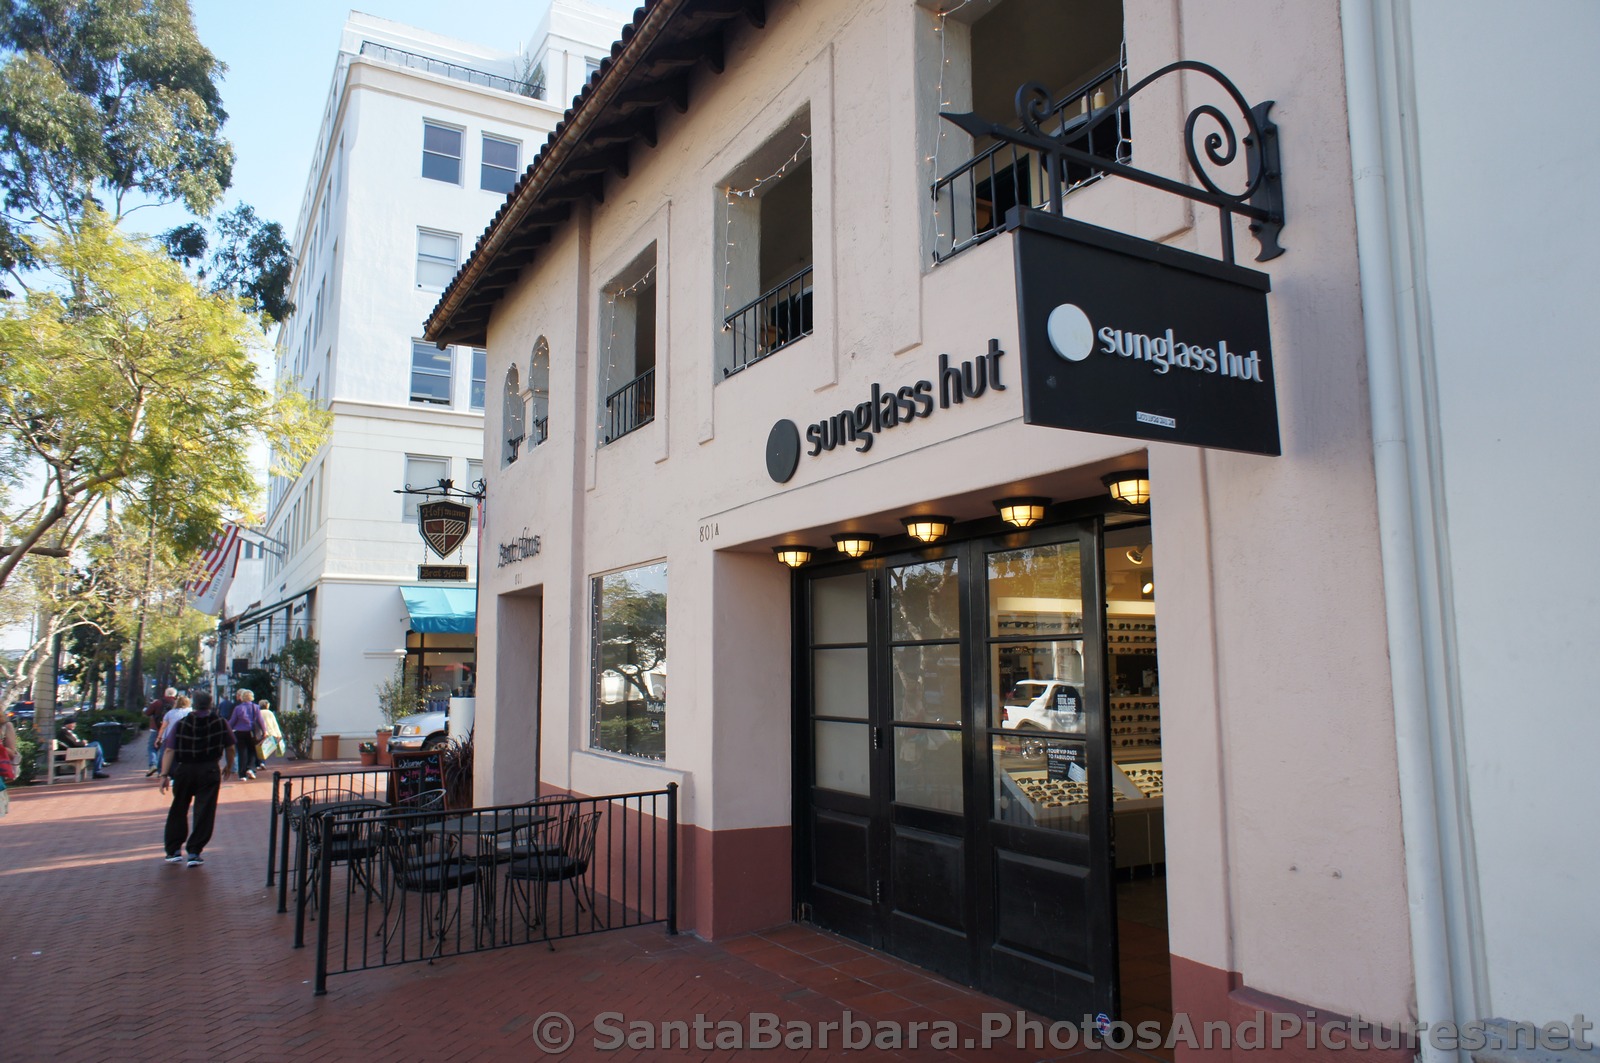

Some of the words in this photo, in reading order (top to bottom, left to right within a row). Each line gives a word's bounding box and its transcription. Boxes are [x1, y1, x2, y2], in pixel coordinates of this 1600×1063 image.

[1098, 326, 1218, 375] sunglass
[1218, 340, 1263, 383] hut
[806, 380, 934, 457] sunglass
[938, 338, 1006, 409] hut
[422, 505, 466, 518] Hoffmann
